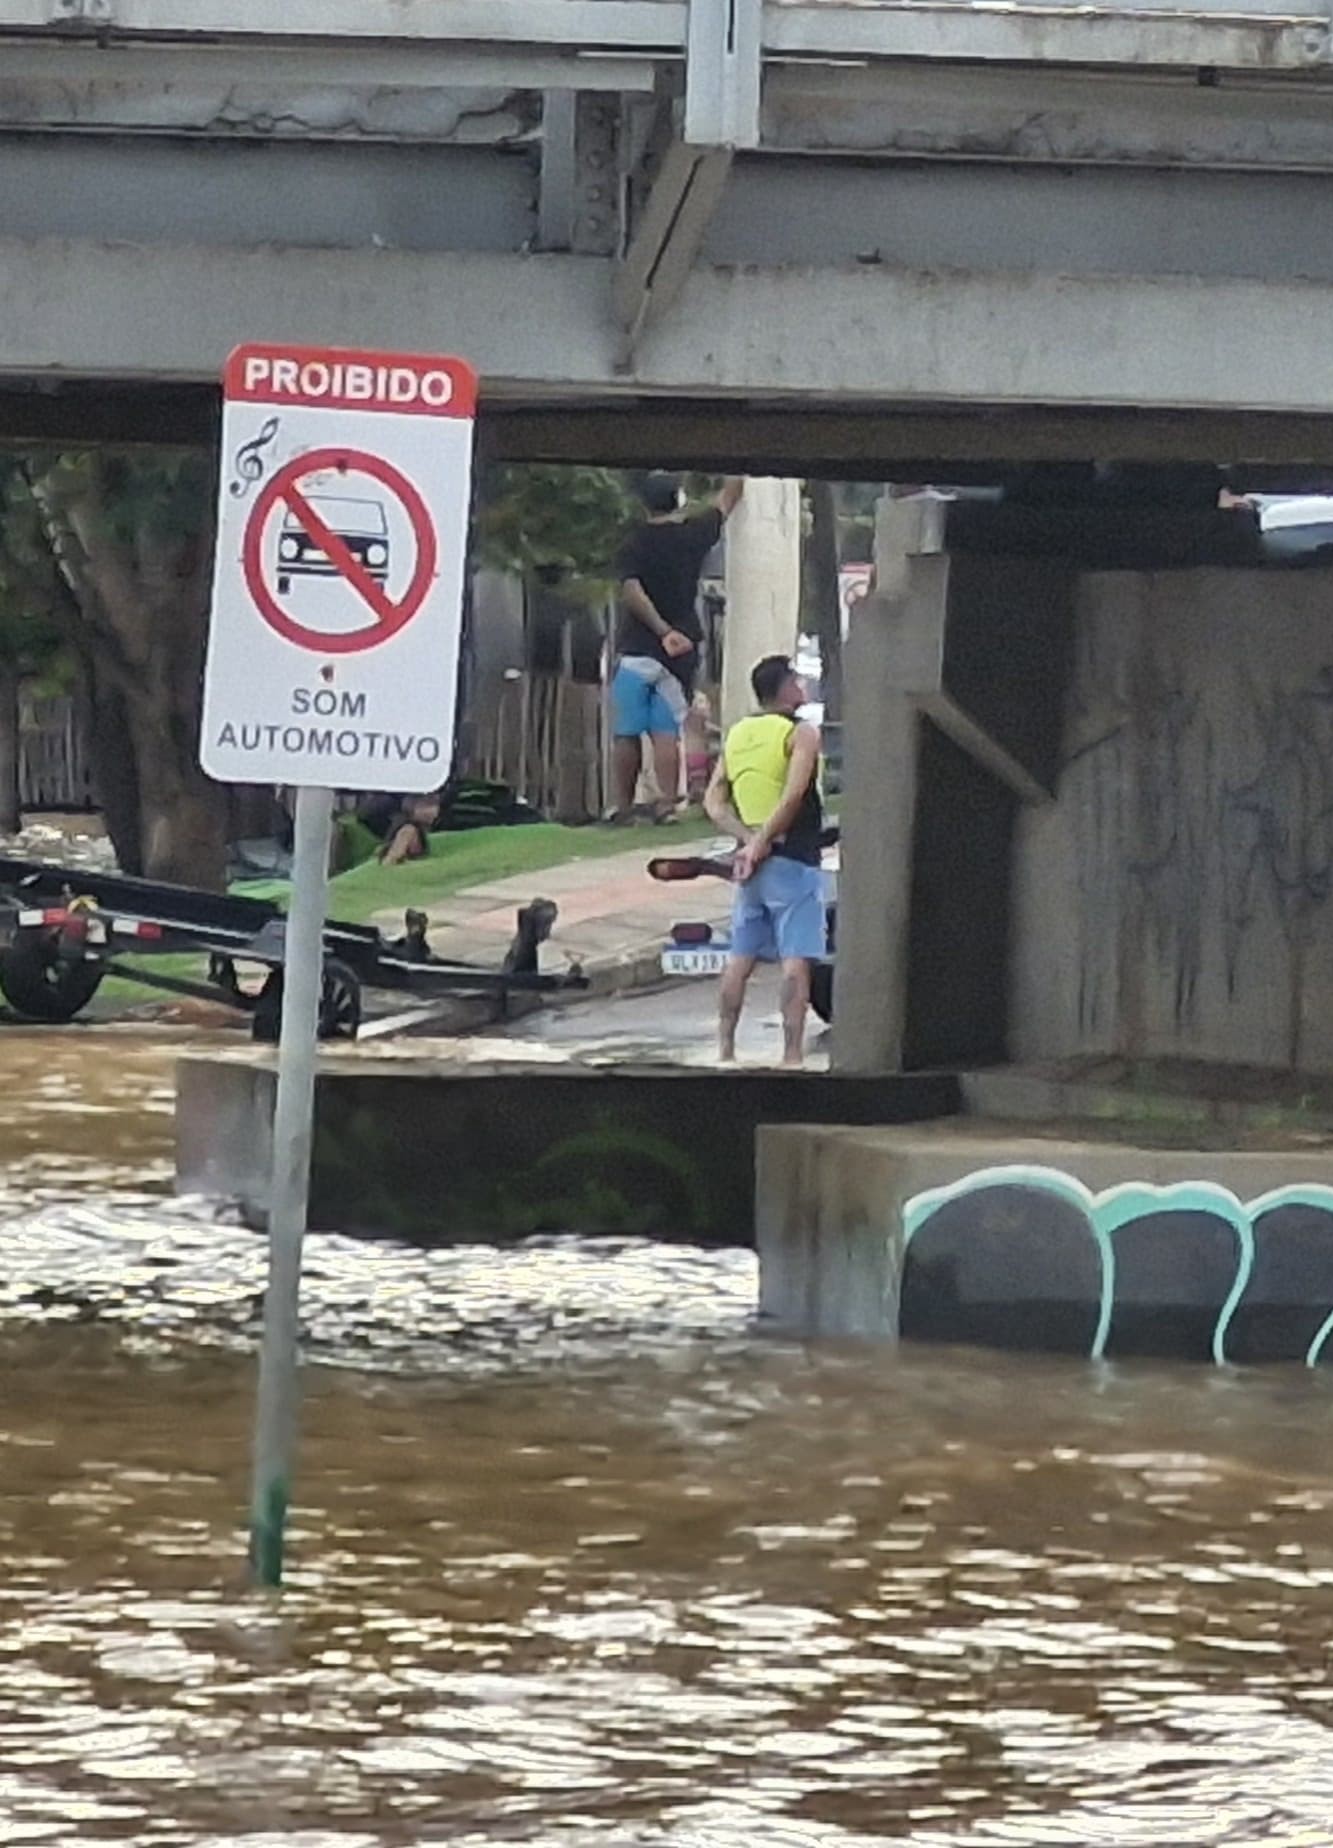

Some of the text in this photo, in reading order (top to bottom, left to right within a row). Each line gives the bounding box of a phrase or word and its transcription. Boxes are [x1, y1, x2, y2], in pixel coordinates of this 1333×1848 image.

[244, 358, 453, 406] PROIBIDO
[291, 688, 367, 718] SOM
[216, 723, 440, 763] AUTOMOTIVO
